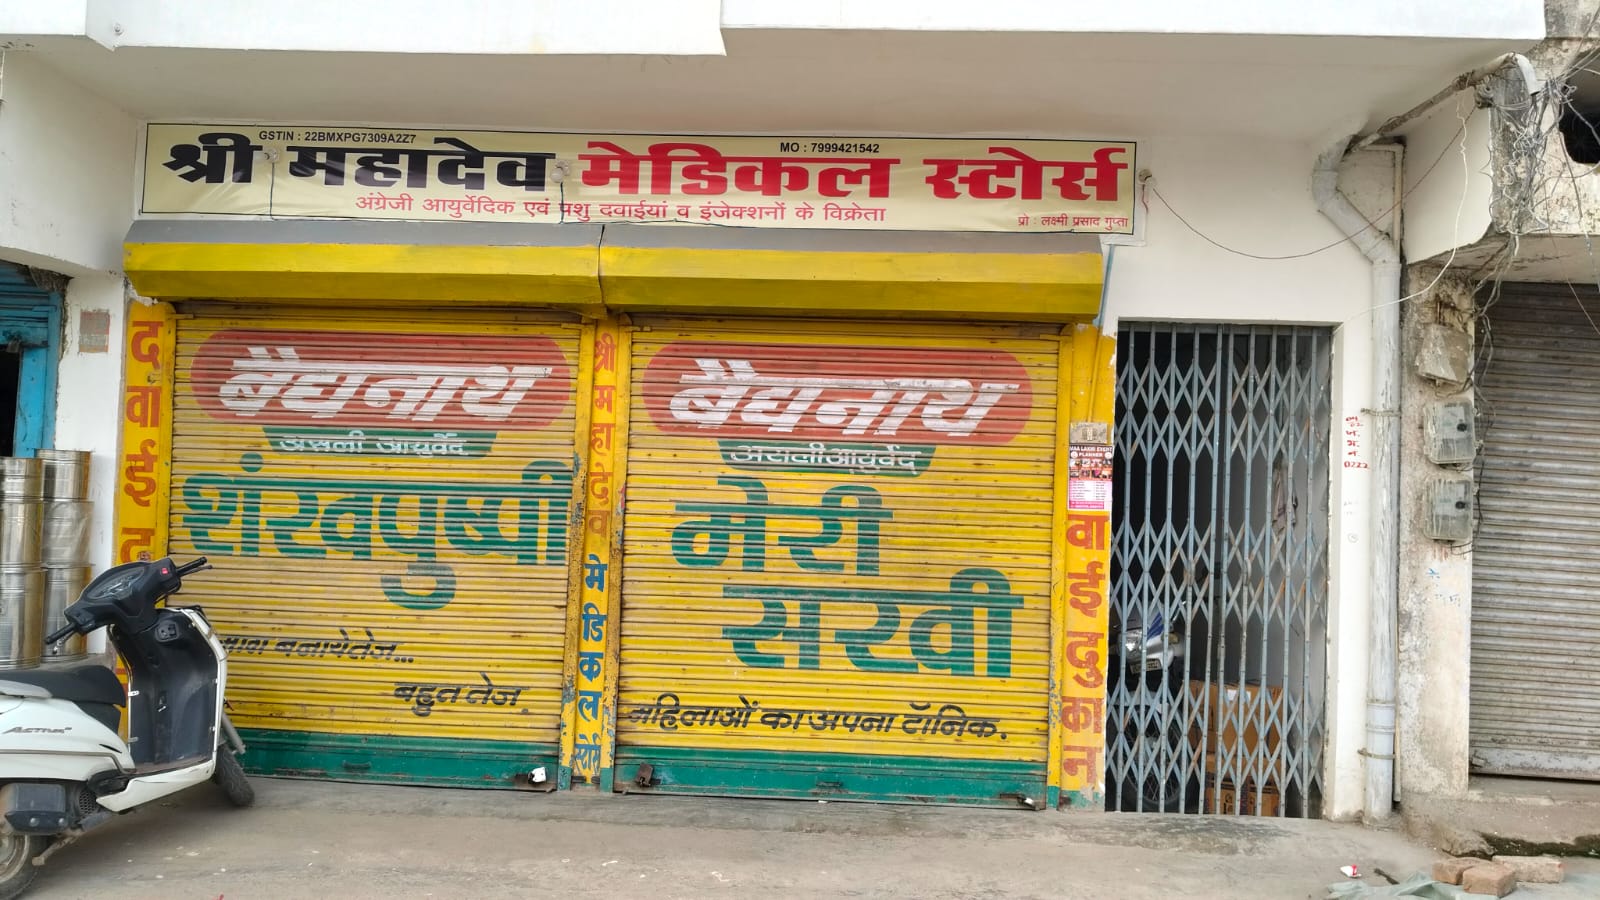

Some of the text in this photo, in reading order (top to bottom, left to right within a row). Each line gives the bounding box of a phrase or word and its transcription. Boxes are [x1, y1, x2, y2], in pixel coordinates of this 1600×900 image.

[259, 130, 294, 141] GSTIN
[304, 131, 417, 144] 22BMXPG7309A2Z7
[779, 142, 800, 152] MO
[811, 143, 880, 153] 7999421542
[162, 132, 1128, 202] श्री महादेव मेडिकल स्टोर्स
[356, 191, 887, 222] अंग्रेजी आयुर्वेदिक एवं पशु दवाईयां व इंजेक्शनों के विक्रेता
[1041, 213, 1068, 226] लक्ष्मी
[1072, 216, 1101, 227] प्रसाद
[1104, 216, 1129, 231] गुप्ता
[280, 429, 367, 453] असली
[182, 452, 573, 611] शंखपुष्पी
[670, 475, 894, 577] मेरी
[722, 567, 1025, 678] सखी
